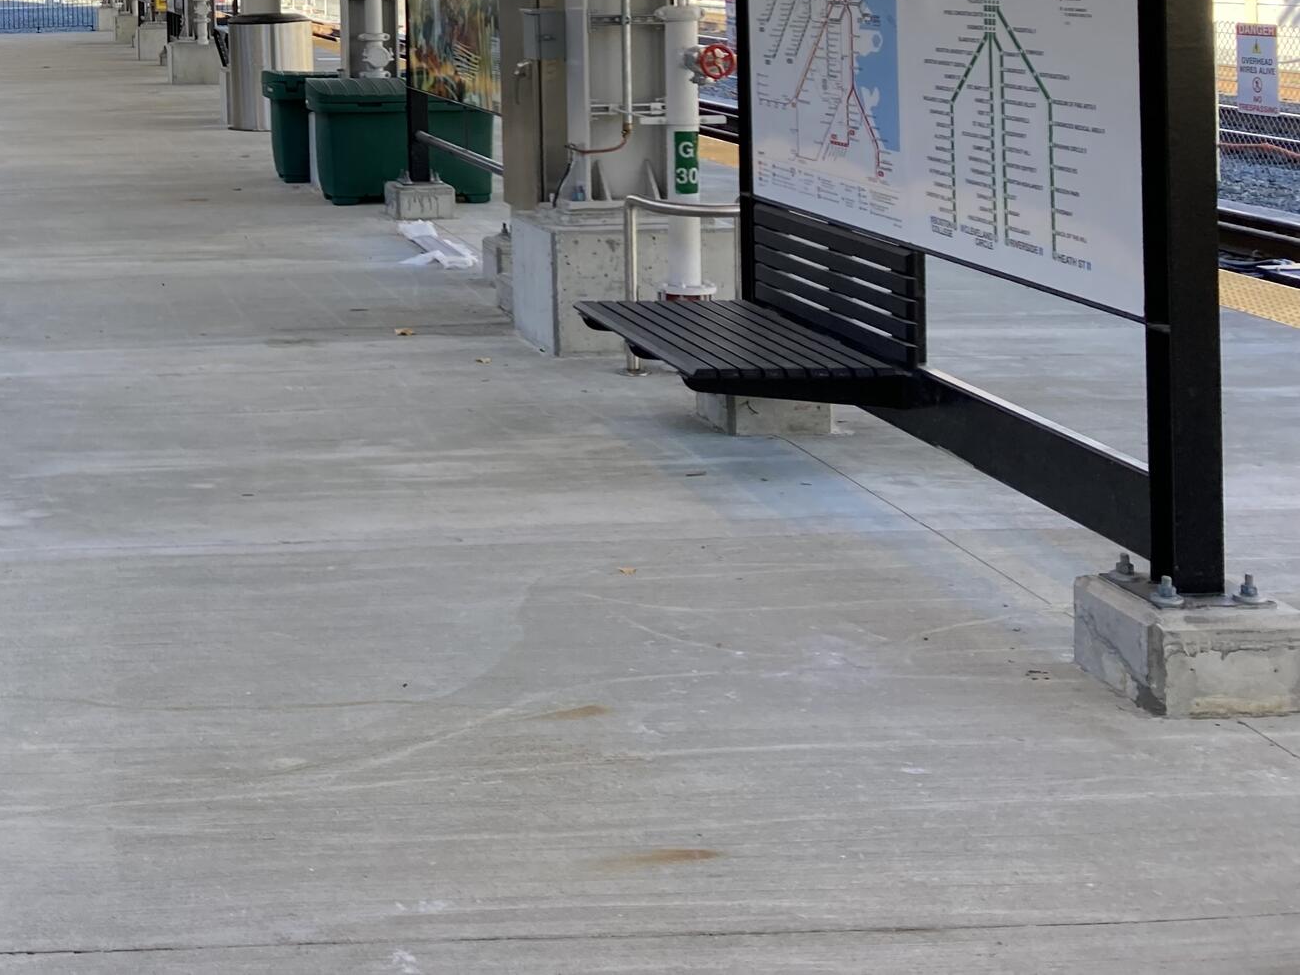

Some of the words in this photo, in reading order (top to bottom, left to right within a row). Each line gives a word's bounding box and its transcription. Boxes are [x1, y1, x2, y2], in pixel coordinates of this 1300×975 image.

[1239, 25, 1275, 36] DANGER
[1241, 57, 1273, 66] OVERHEAD
[1240, 66, 1257, 74] WIRES
[1259, 68, 1276, 76] ALIVE
[679, 141, 694, 158] G
[676, 167, 698, 184] 30
